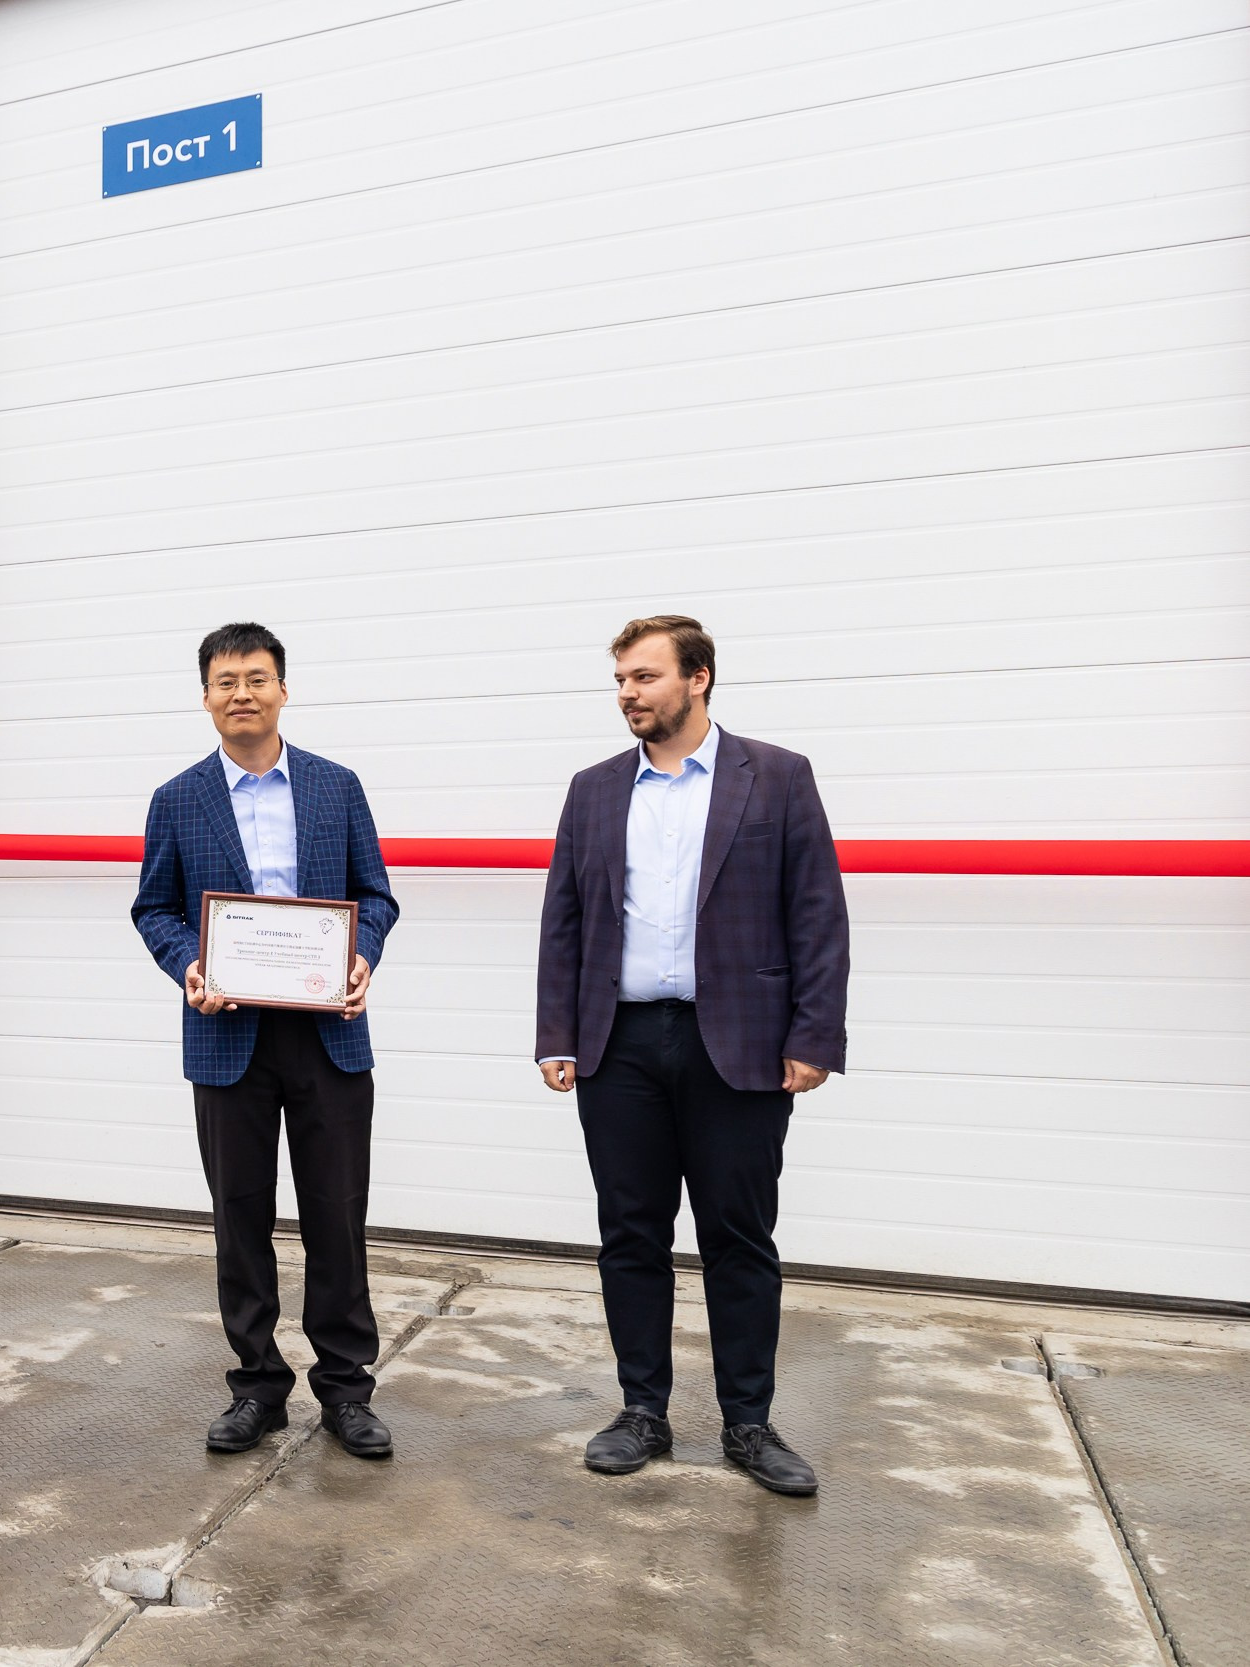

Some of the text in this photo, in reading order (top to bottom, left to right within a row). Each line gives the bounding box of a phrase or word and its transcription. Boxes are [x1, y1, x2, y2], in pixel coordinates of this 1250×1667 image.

[127, 121, 237, 172] Пост 1
[256, 930, 302, 938] СЕРТИФИКАТ
